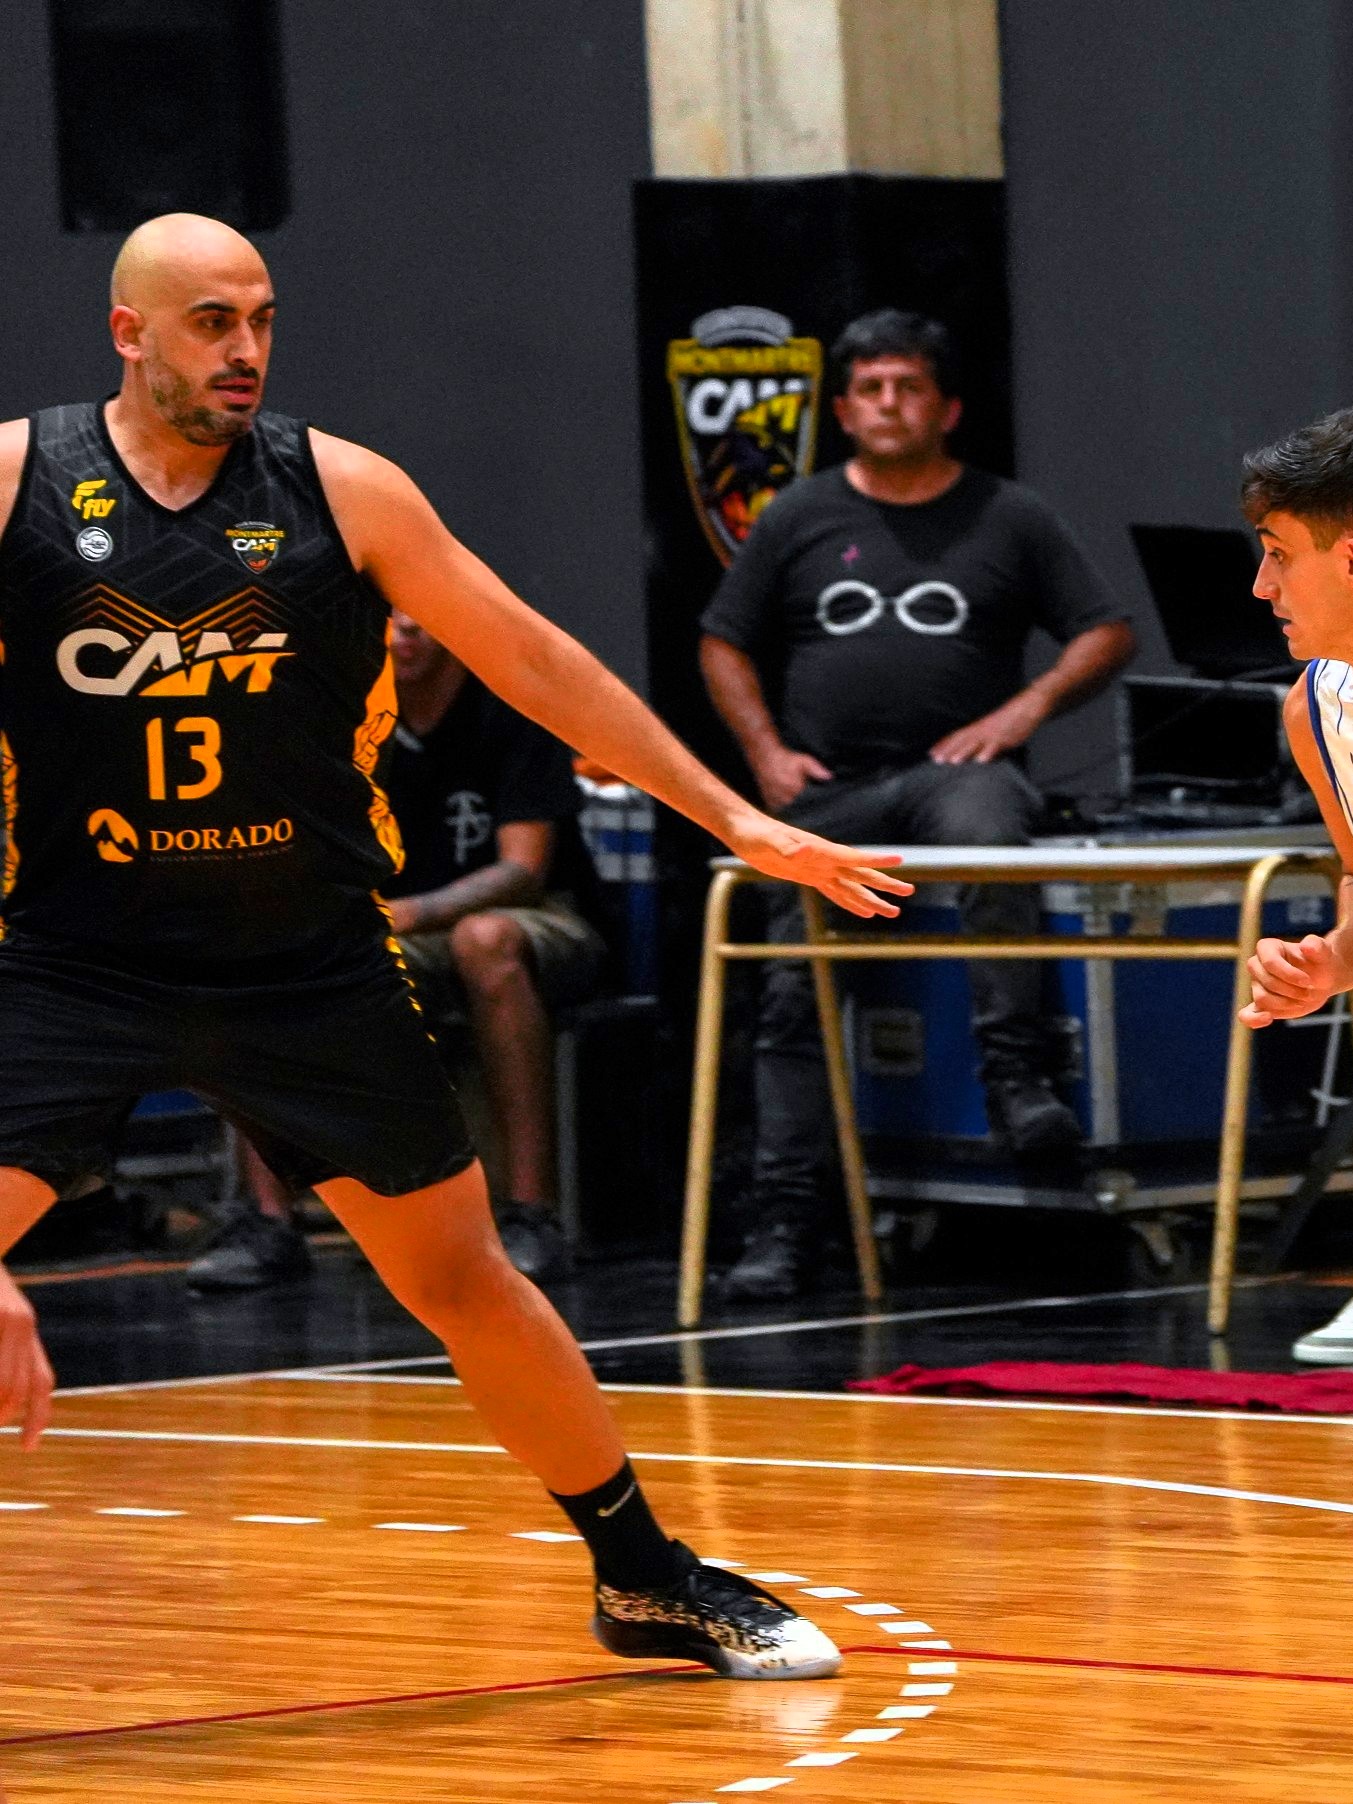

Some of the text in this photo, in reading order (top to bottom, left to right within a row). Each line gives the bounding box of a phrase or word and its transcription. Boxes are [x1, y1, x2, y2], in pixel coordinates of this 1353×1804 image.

[56, 627, 297, 697] CAM
[145, 715, 223, 800] 13
[149, 818, 294, 851] DORADO
